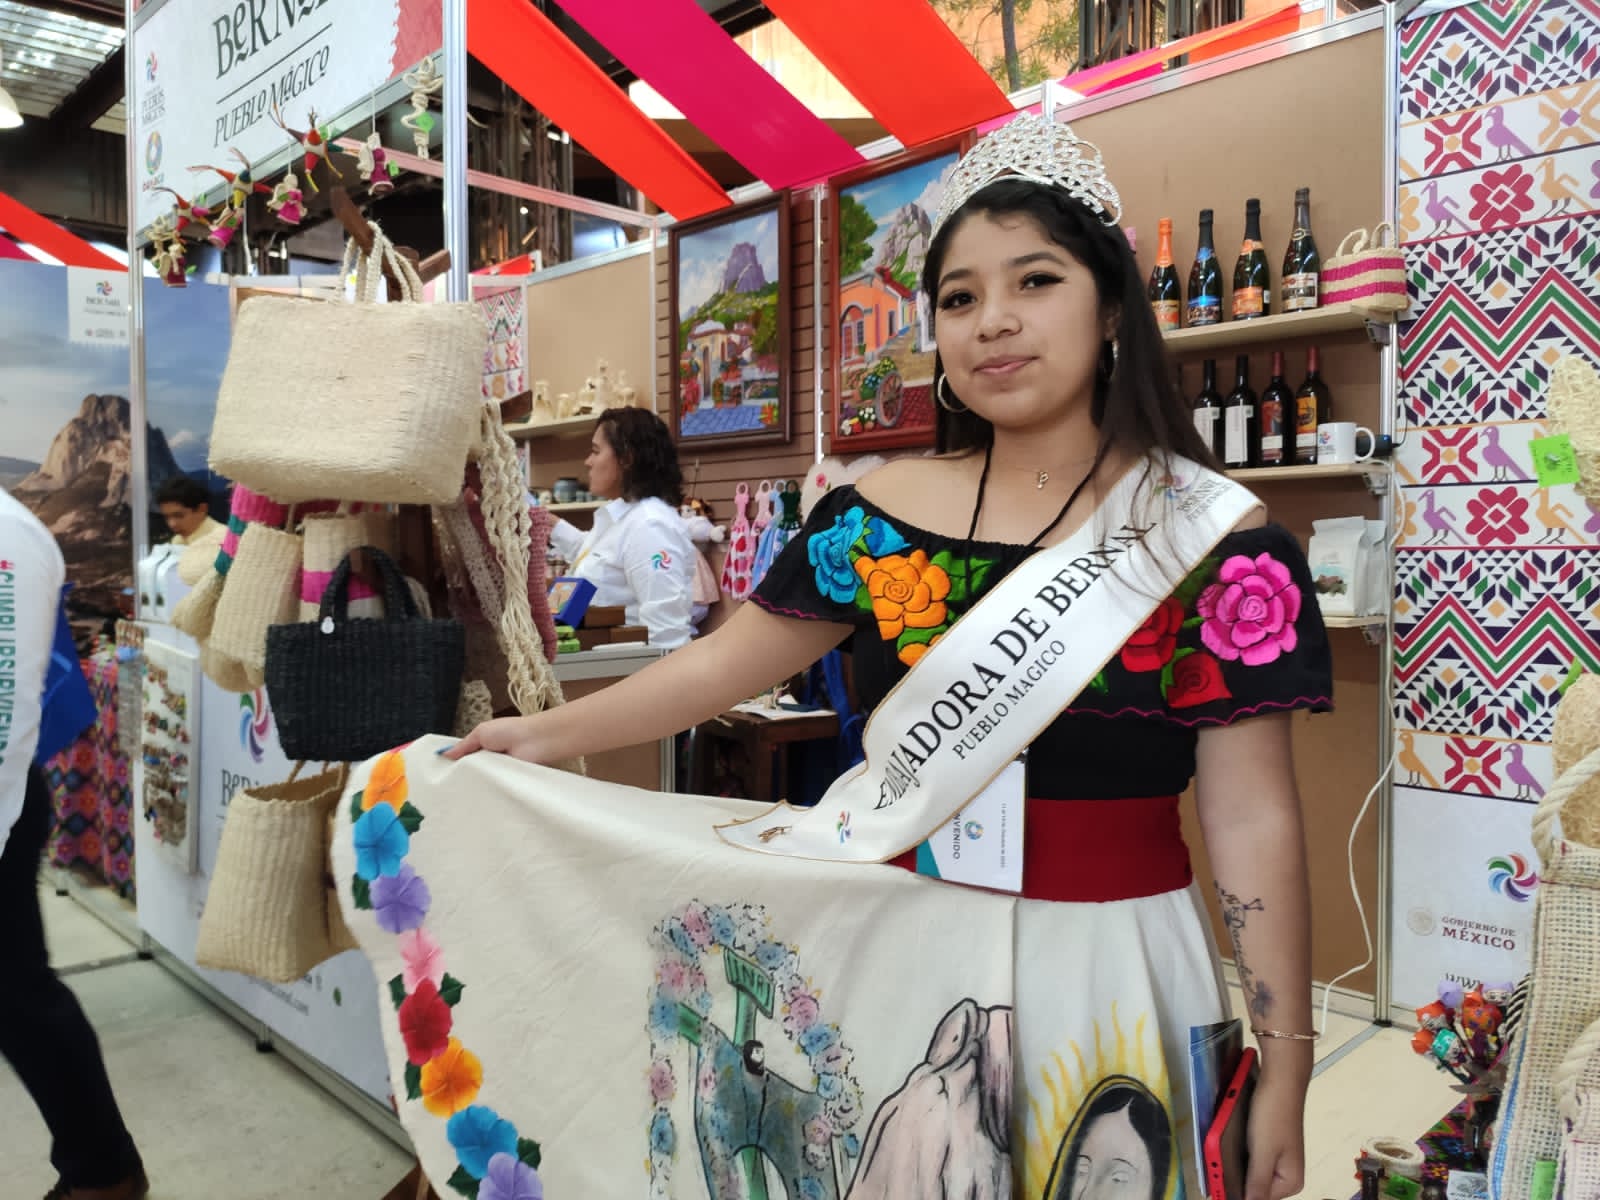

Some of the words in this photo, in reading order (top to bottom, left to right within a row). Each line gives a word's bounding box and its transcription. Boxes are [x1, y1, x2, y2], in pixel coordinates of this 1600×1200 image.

[213, 89, 267, 148] PUEBLO
[990, 607, 1050, 666] DE
[1034, 522, 1157, 616] BERNAL
[952, 701, 1010, 760] PUEBLO
[1004, 639, 1066, 706] MAGICO
[952, 812, 961, 861] NVENIDO
[1441, 916, 1498, 934] GOBIERNO
[1500, 927, 1517, 937] DE
[1441, 926, 1516, 951] MÉXICO
